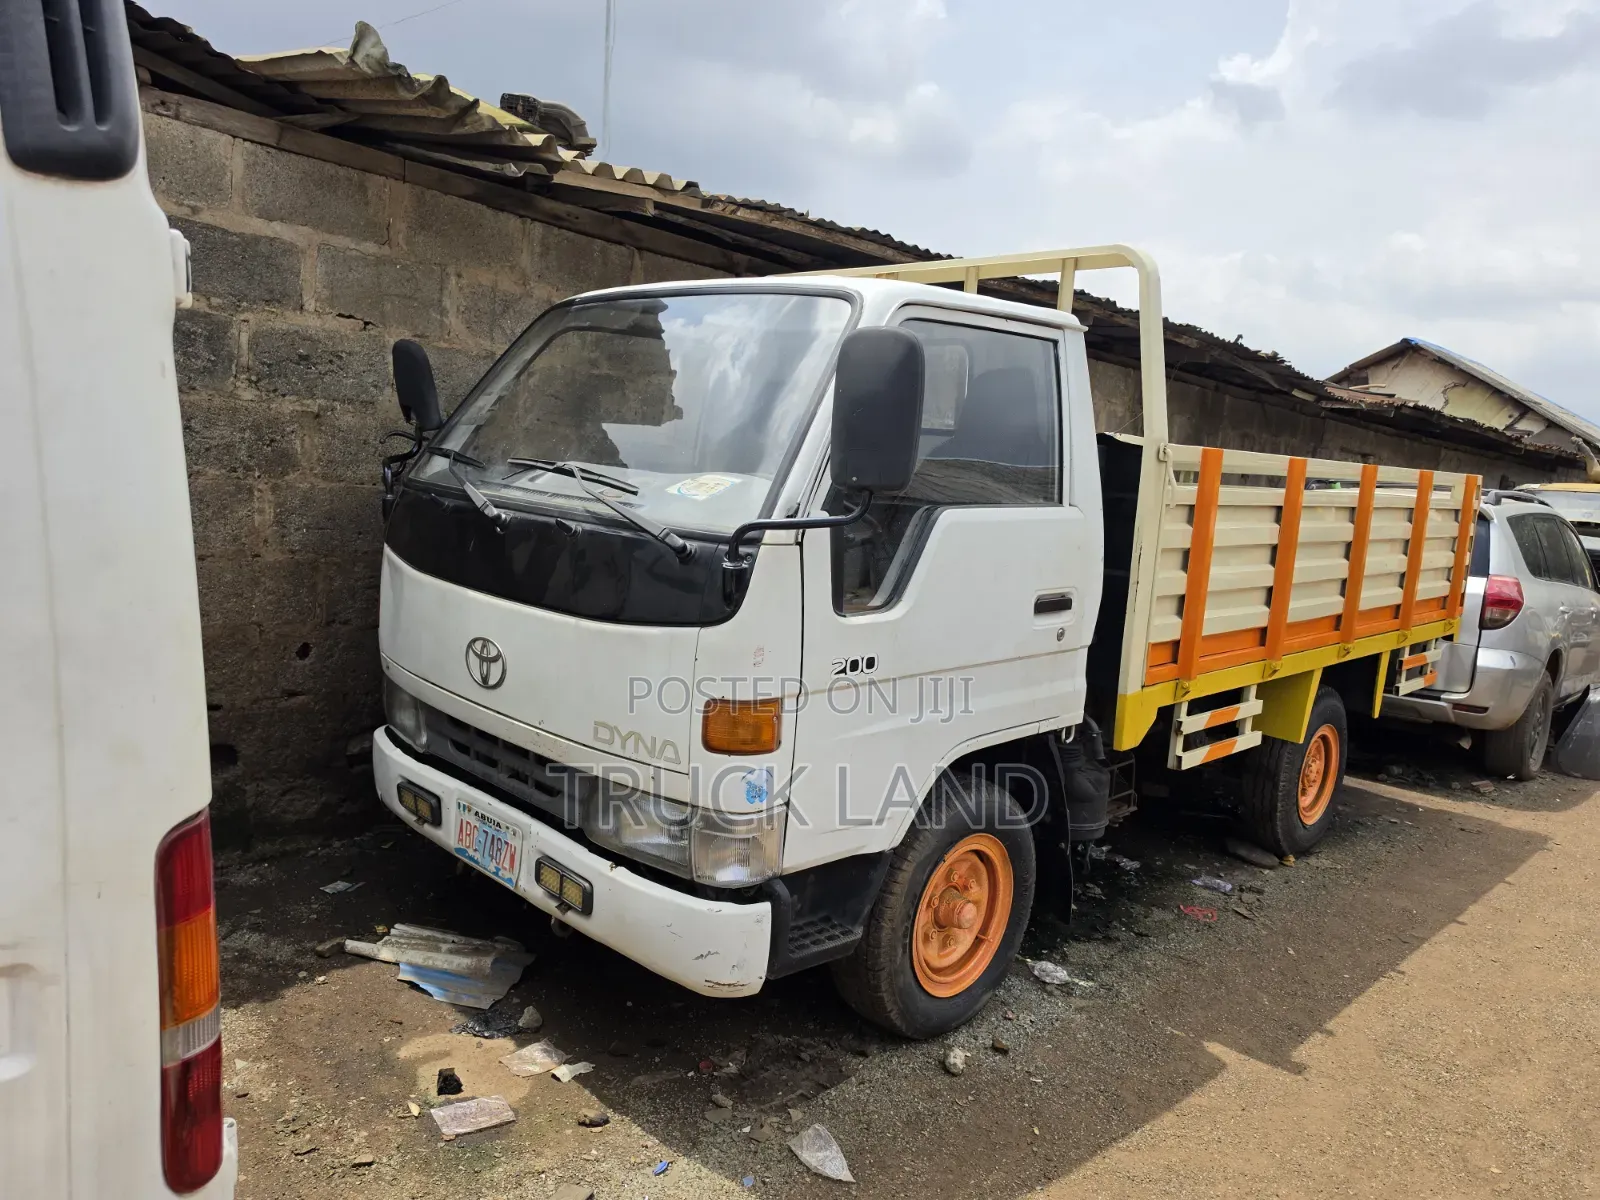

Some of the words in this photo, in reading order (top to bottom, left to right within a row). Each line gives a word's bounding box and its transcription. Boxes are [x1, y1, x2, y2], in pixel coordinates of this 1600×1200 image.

[831, 654, 879, 677] 200
[593, 720, 681, 765] DYNA
[474, 810, 502, 829] ABUJA
